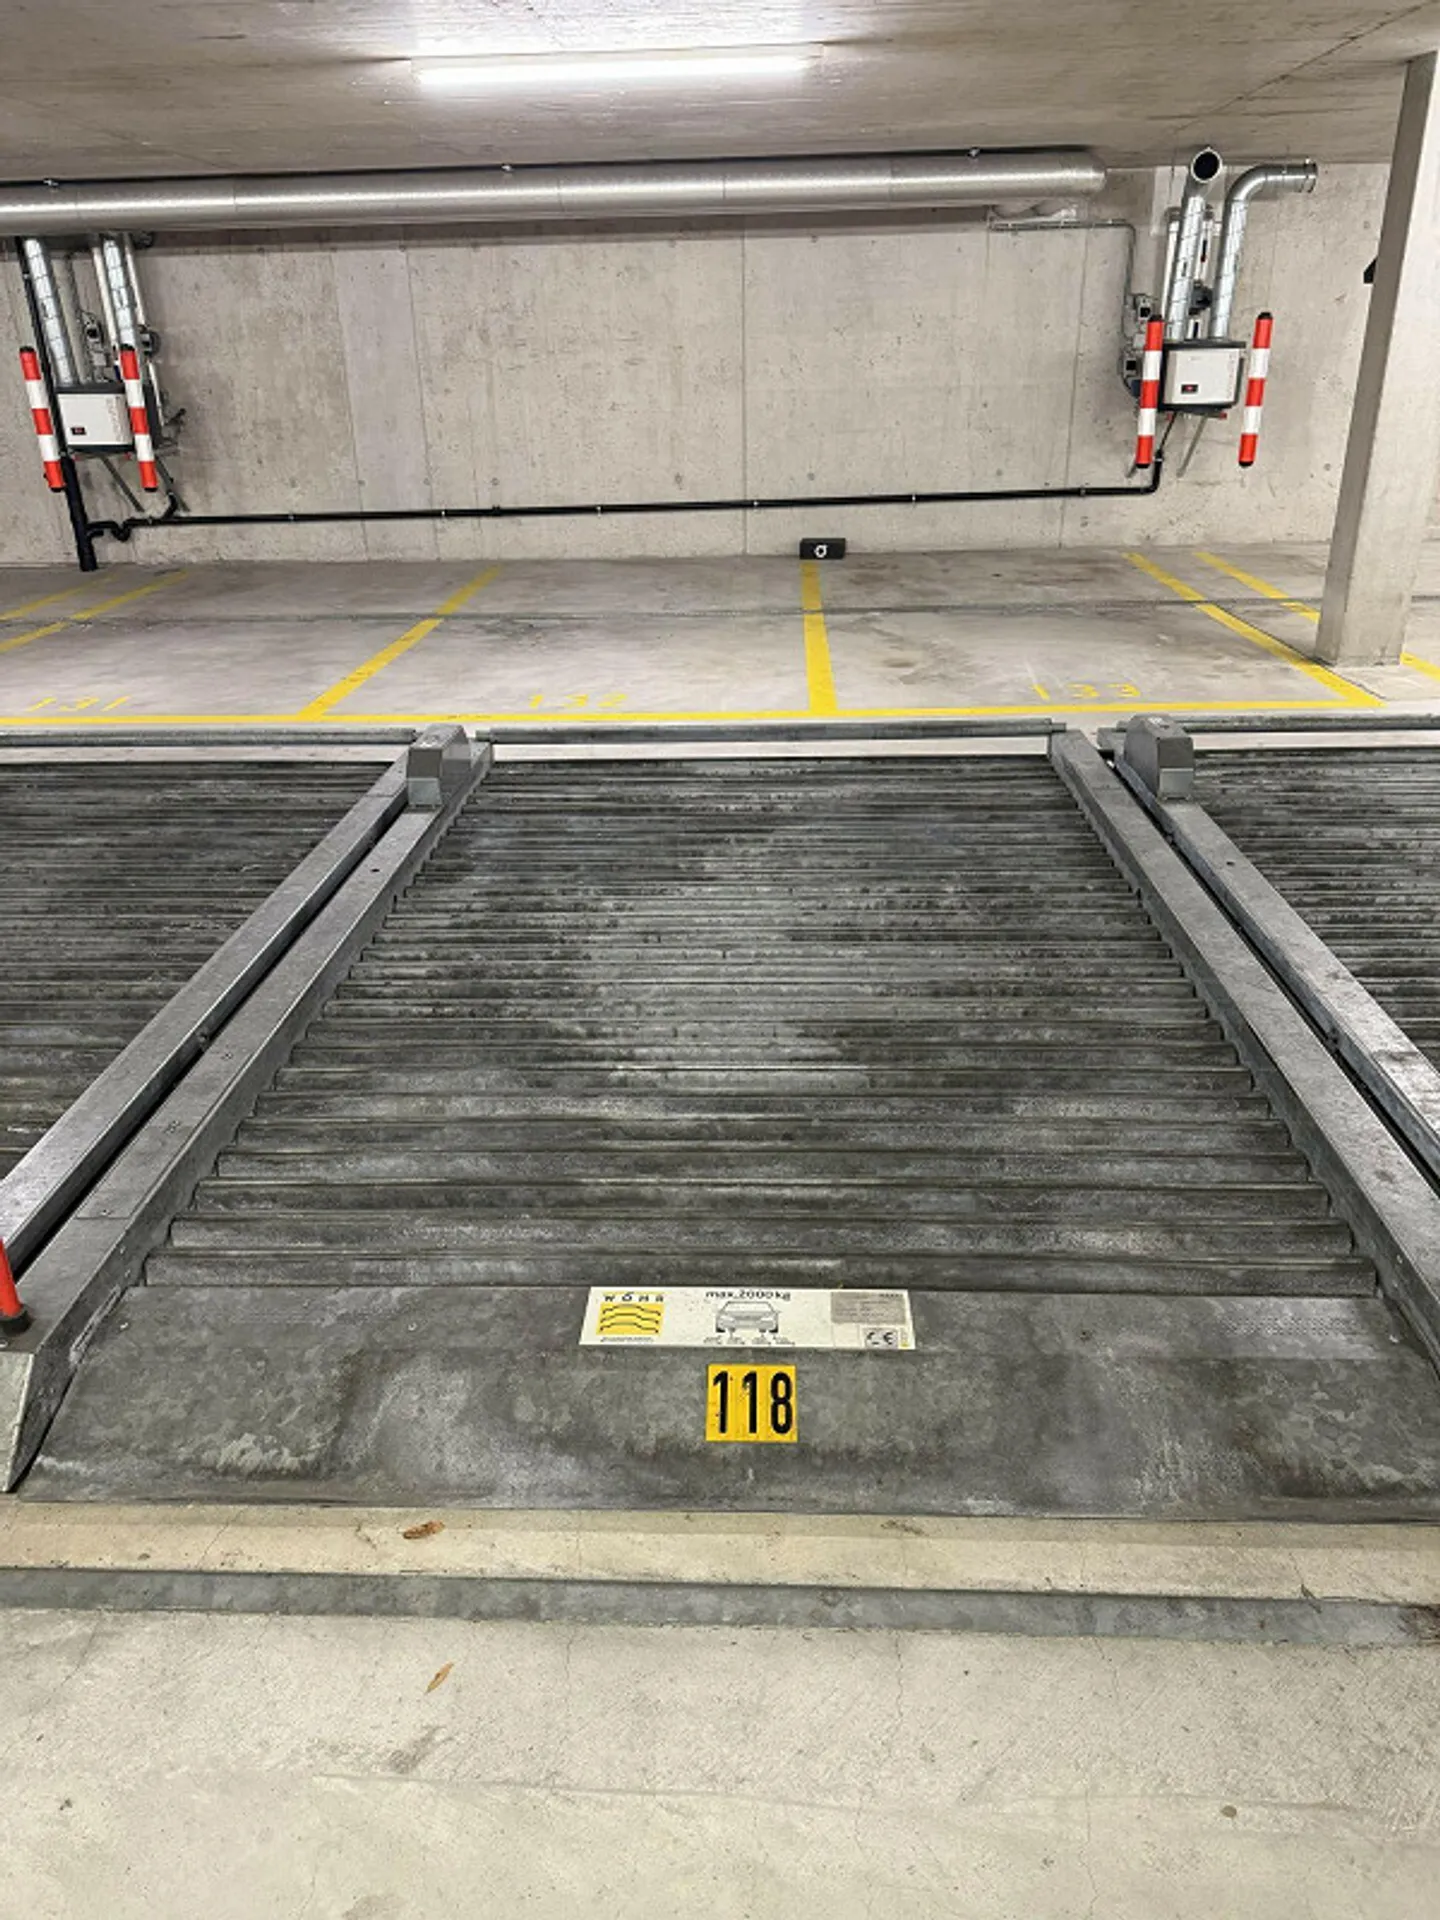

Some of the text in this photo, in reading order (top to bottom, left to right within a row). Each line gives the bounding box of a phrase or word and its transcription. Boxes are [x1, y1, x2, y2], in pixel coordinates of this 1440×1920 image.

[1031, 683, 1140, 700] 133
[26, 696, 131, 712] 131
[529, 694, 627, 709] 132
[712, 1370, 793, 1435] 118
